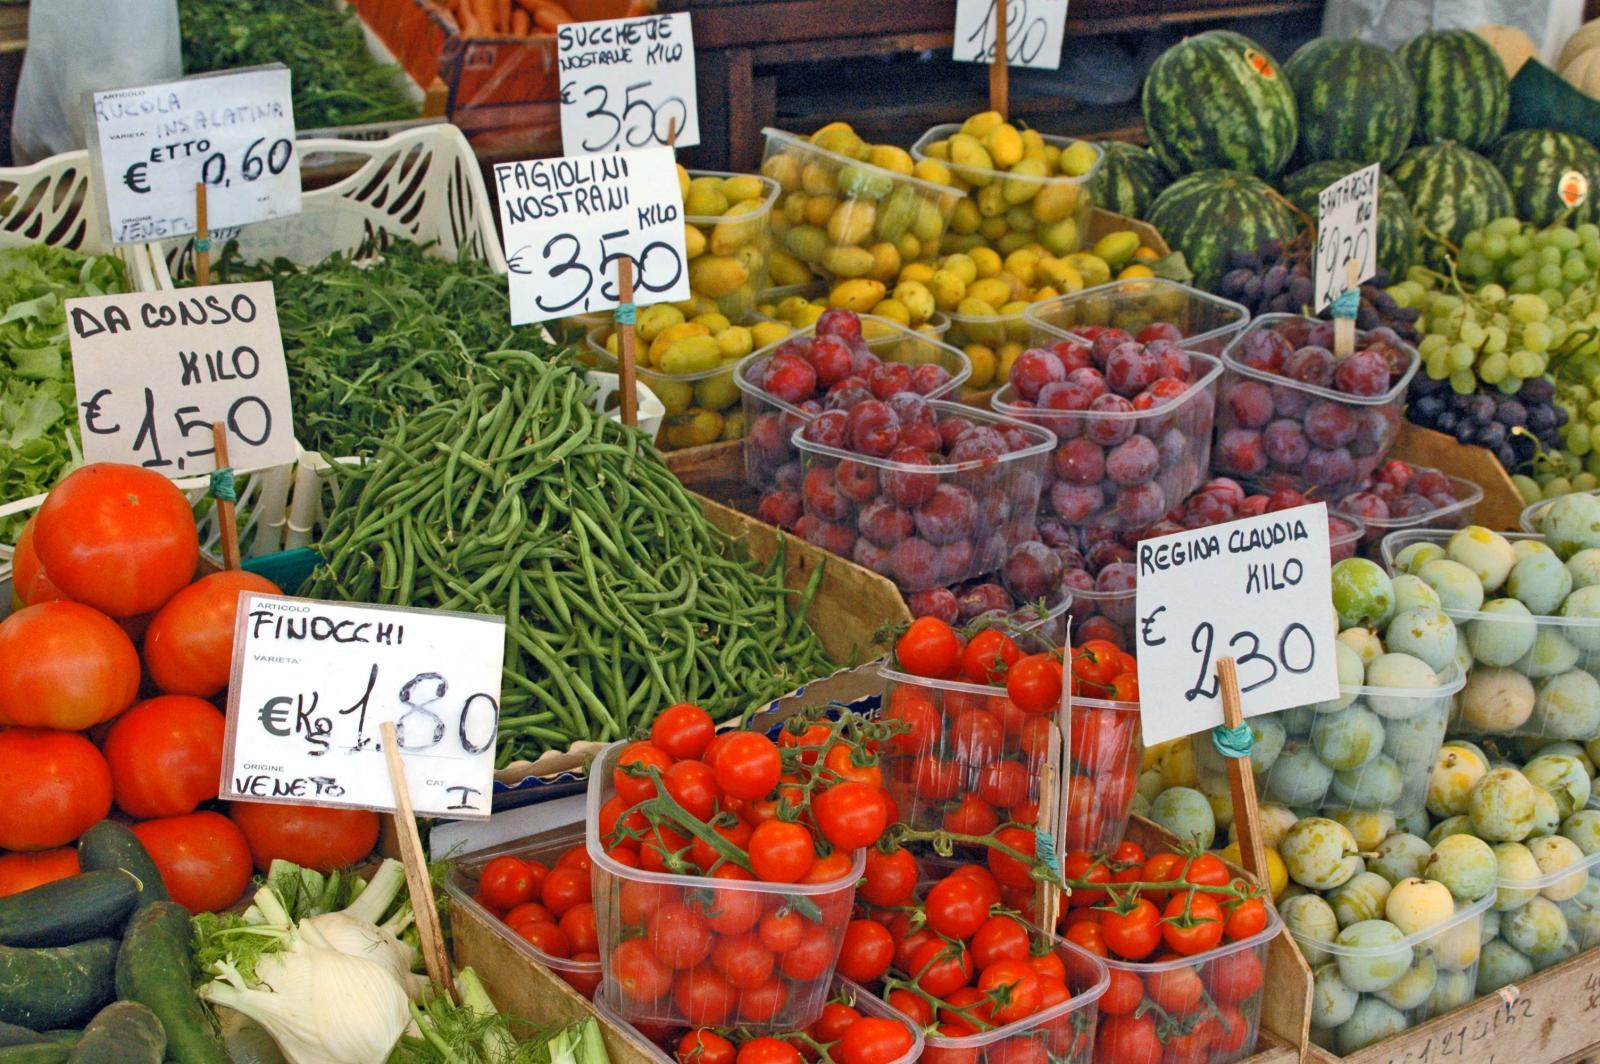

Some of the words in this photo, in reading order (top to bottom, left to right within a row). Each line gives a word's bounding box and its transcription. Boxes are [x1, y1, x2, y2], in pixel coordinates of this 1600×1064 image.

[560, 47, 633, 72] NOSTRANE
[647, 43, 683, 65] KILO
[94, 93, 181, 121] RUCOLA
[102, 90, 146, 100] ARTICOLO
[156, 102, 284, 138] INSALATINA
[560, 81, 577, 105] €
[582, 81, 687, 152] 3,50
[123, 162, 151, 193] €
[201, 137, 293, 188] 0,60
[150, 139, 211, 163] ETTO
[496, 155, 629, 194] FAGIOLINI
[506, 185, 630, 224] NOSTRANI
[637, 203, 677, 230] KILO
[506, 245, 532, 274] €
[535, 229, 682, 312] 3,50
[71, 305, 131, 338] DA
[179, 346, 260, 386] KILO
[81, 389, 121, 434] €
[133, 387, 272, 470] 1,50
[1140, 536, 1220, 577] REGINA
[1228, 520, 1308, 553] CLAUDIA
[1246, 558, 1303, 594] KILO
[257, 602, 311, 613] ARTICOLO
[1141, 605, 1166, 646] €
[250, 610, 404, 645] FINOCCHI
[257, 696, 293, 737] €
[235, 775, 346, 797] VENETO
[243, 763, 285, 773] ORIGINE
